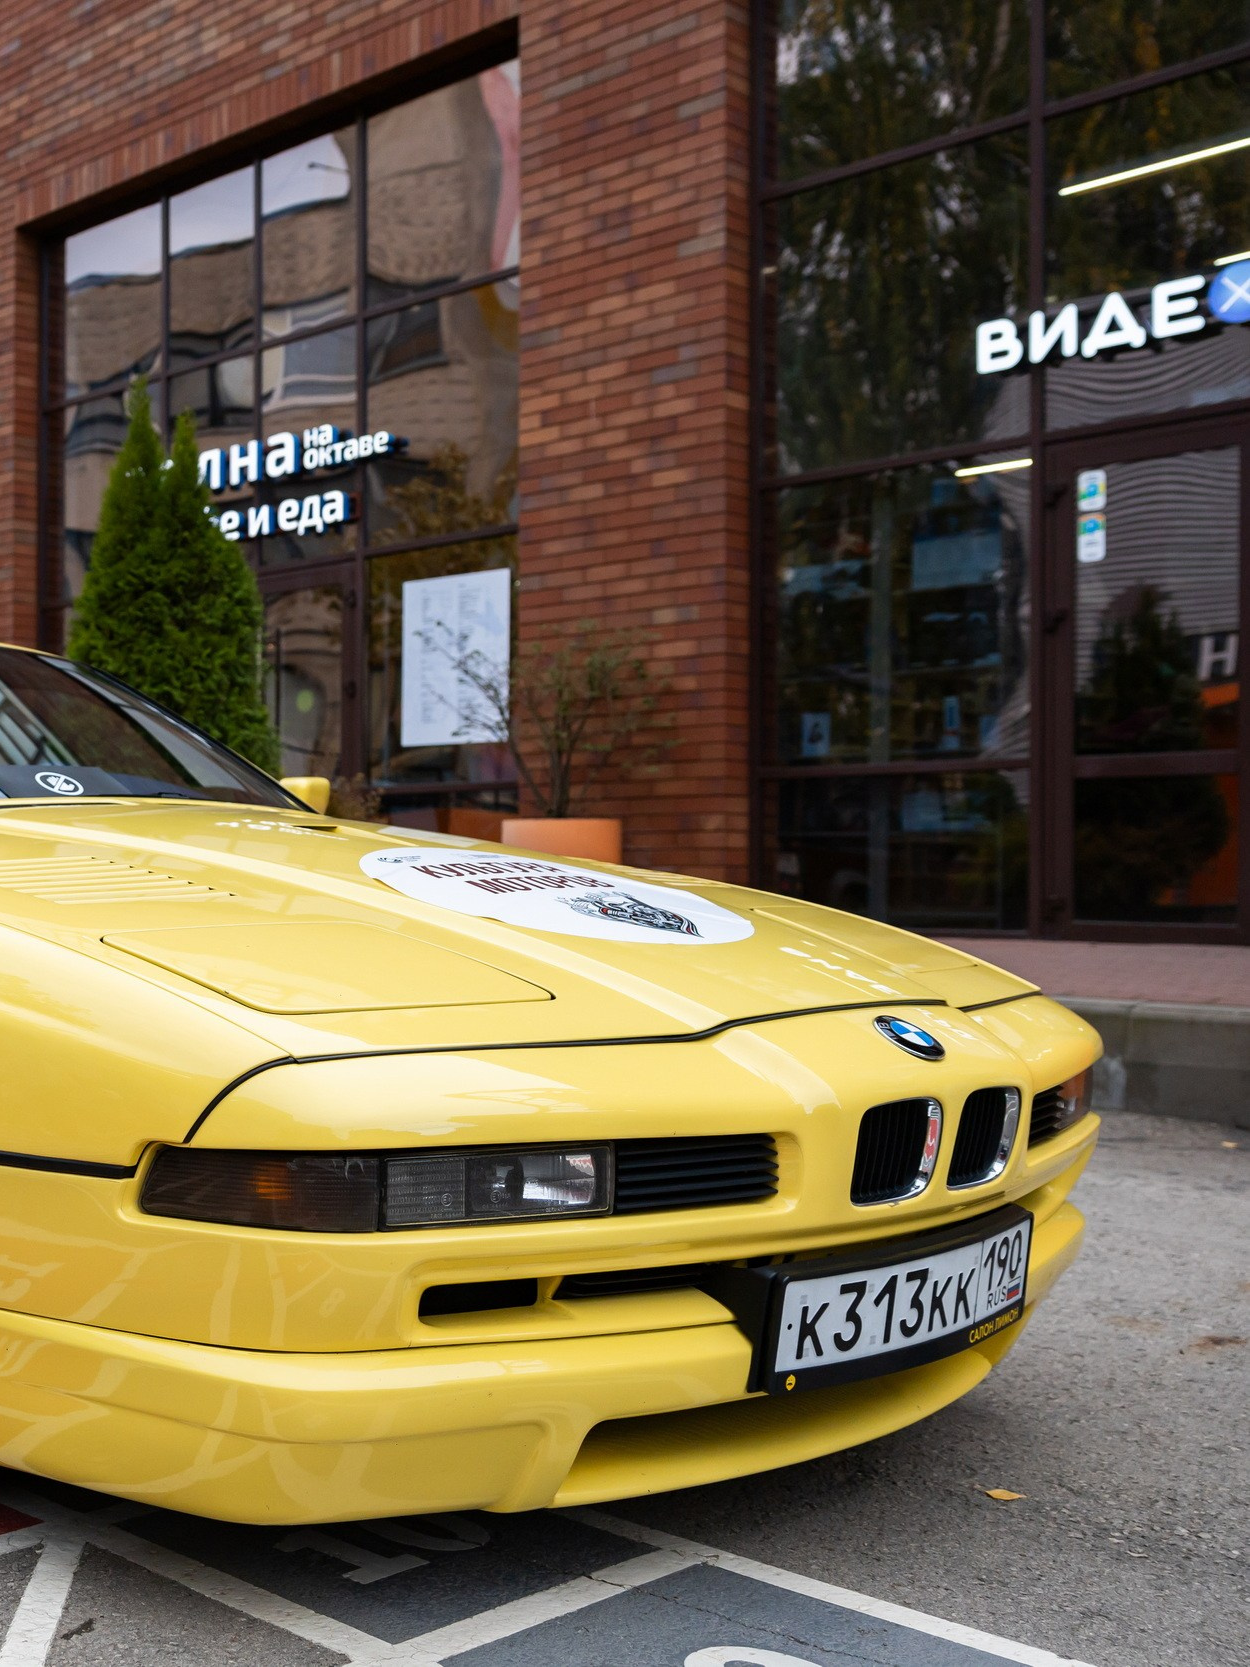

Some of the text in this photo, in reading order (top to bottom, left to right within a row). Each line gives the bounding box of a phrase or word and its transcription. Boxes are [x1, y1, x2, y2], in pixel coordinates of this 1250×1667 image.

[302, 423, 334, 450] на
[302, 430, 391, 470] октаве
[160, 431, 296, 490] лна
[277, 489, 348, 536] еда
[410, 861, 568, 879] КУЛЬТУРА
[464, 875, 615, 895] МОТОРОВ
[983, 1229, 1023, 1292] 190
[986, 1285, 1007, 1310] RUS
[969, 1320, 995, 1343] САЛОН
